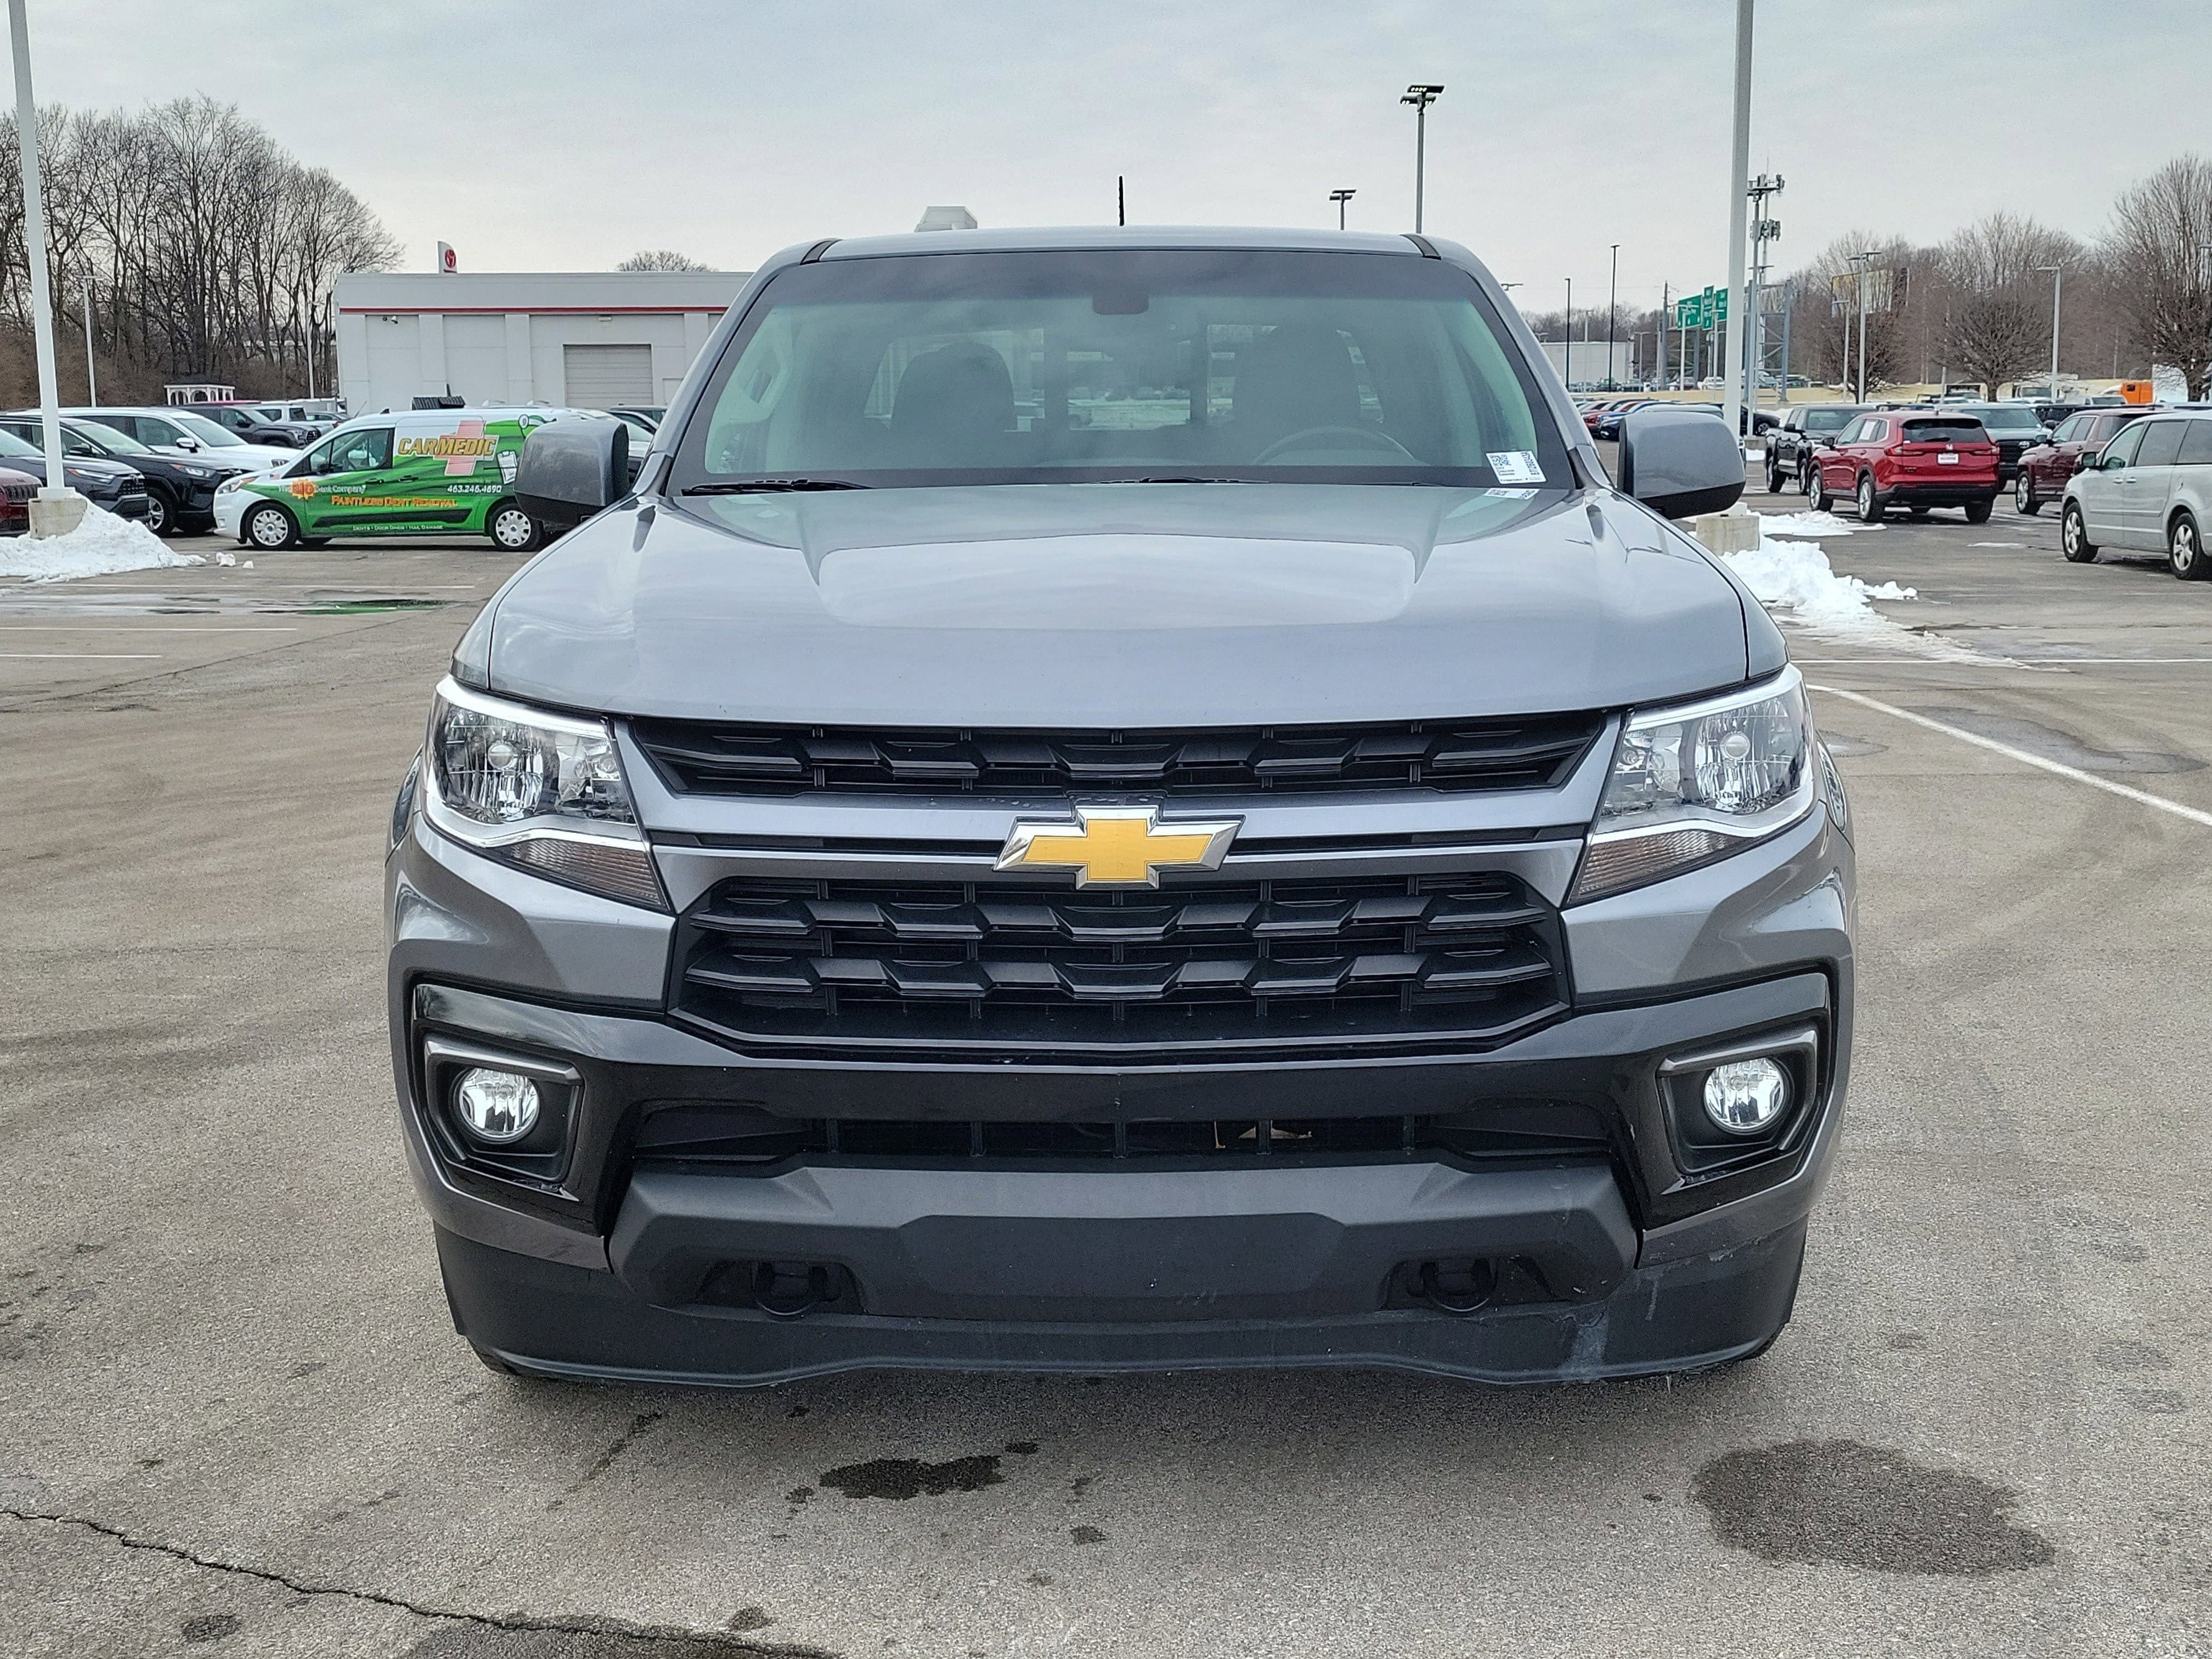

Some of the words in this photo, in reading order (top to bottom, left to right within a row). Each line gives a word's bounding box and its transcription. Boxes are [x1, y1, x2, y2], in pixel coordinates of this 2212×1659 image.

[398, 438, 496, 456] CARMEDIC
[332, 484, 366, 494] Company
[447, 485, 502, 493] 463.246.4690
